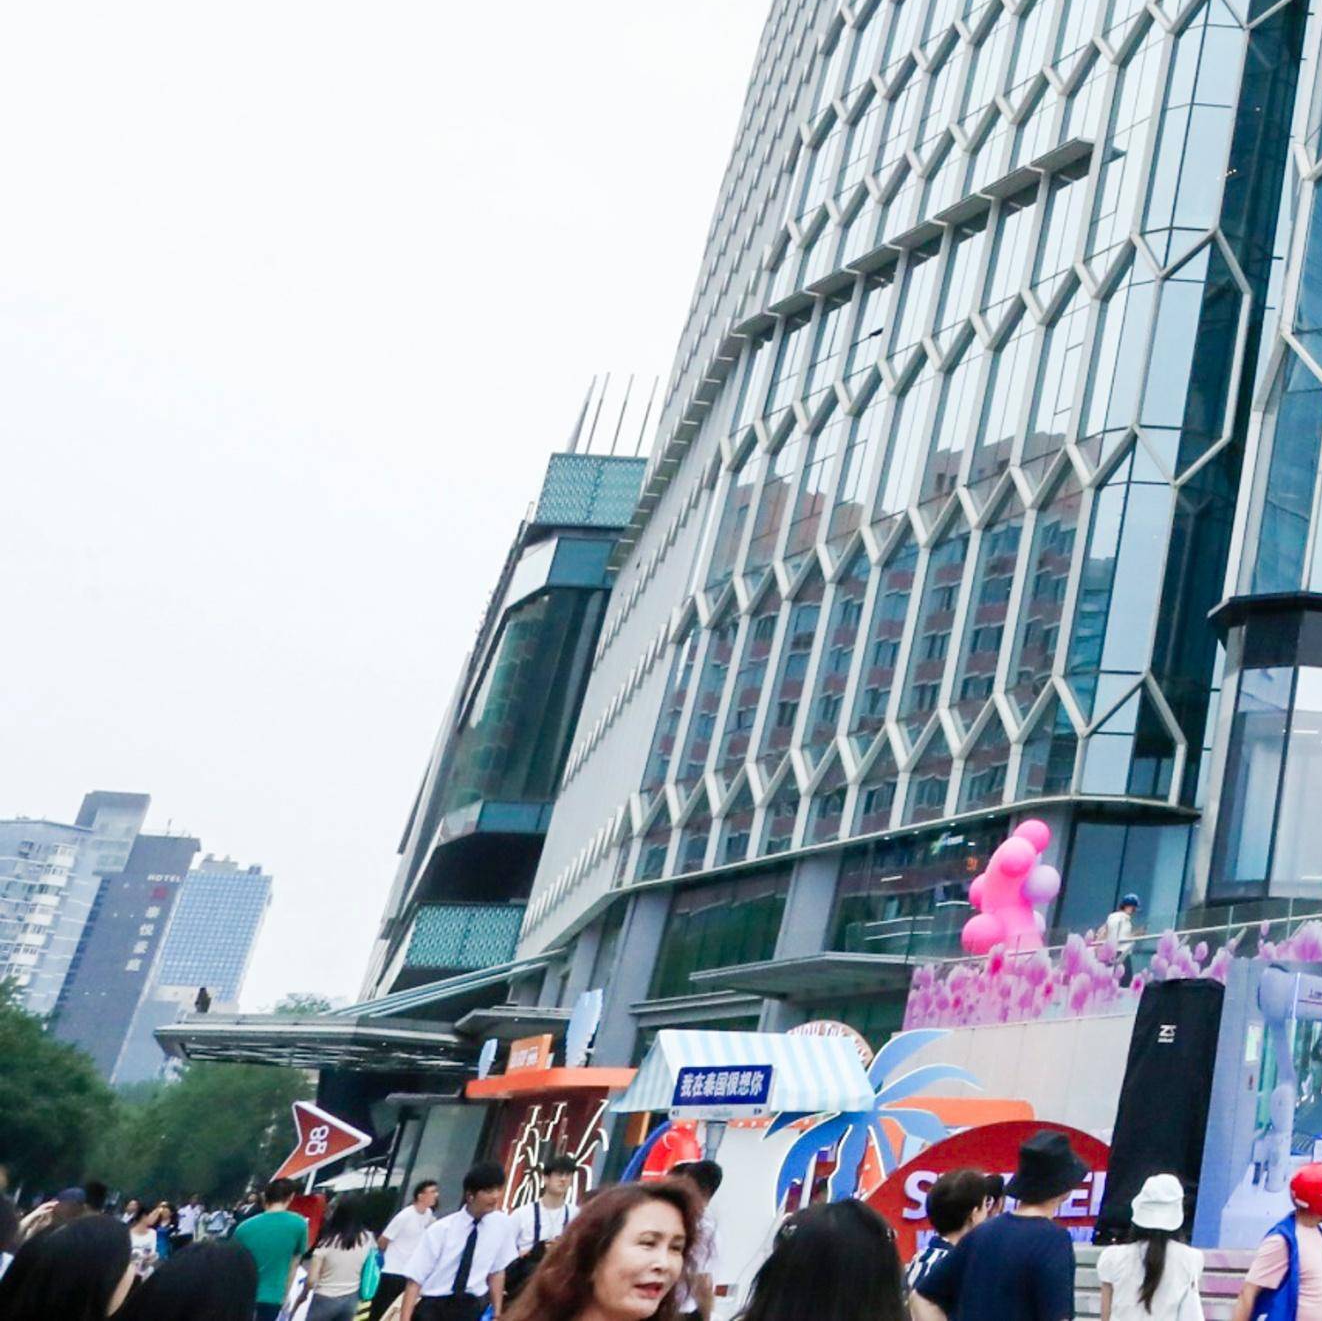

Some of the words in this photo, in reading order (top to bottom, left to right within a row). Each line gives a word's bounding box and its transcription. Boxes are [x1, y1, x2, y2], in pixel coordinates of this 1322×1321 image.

[147, 873, 182, 883] HOTEL
[680, 1070, 765, 1098] 我在泰国很想你
